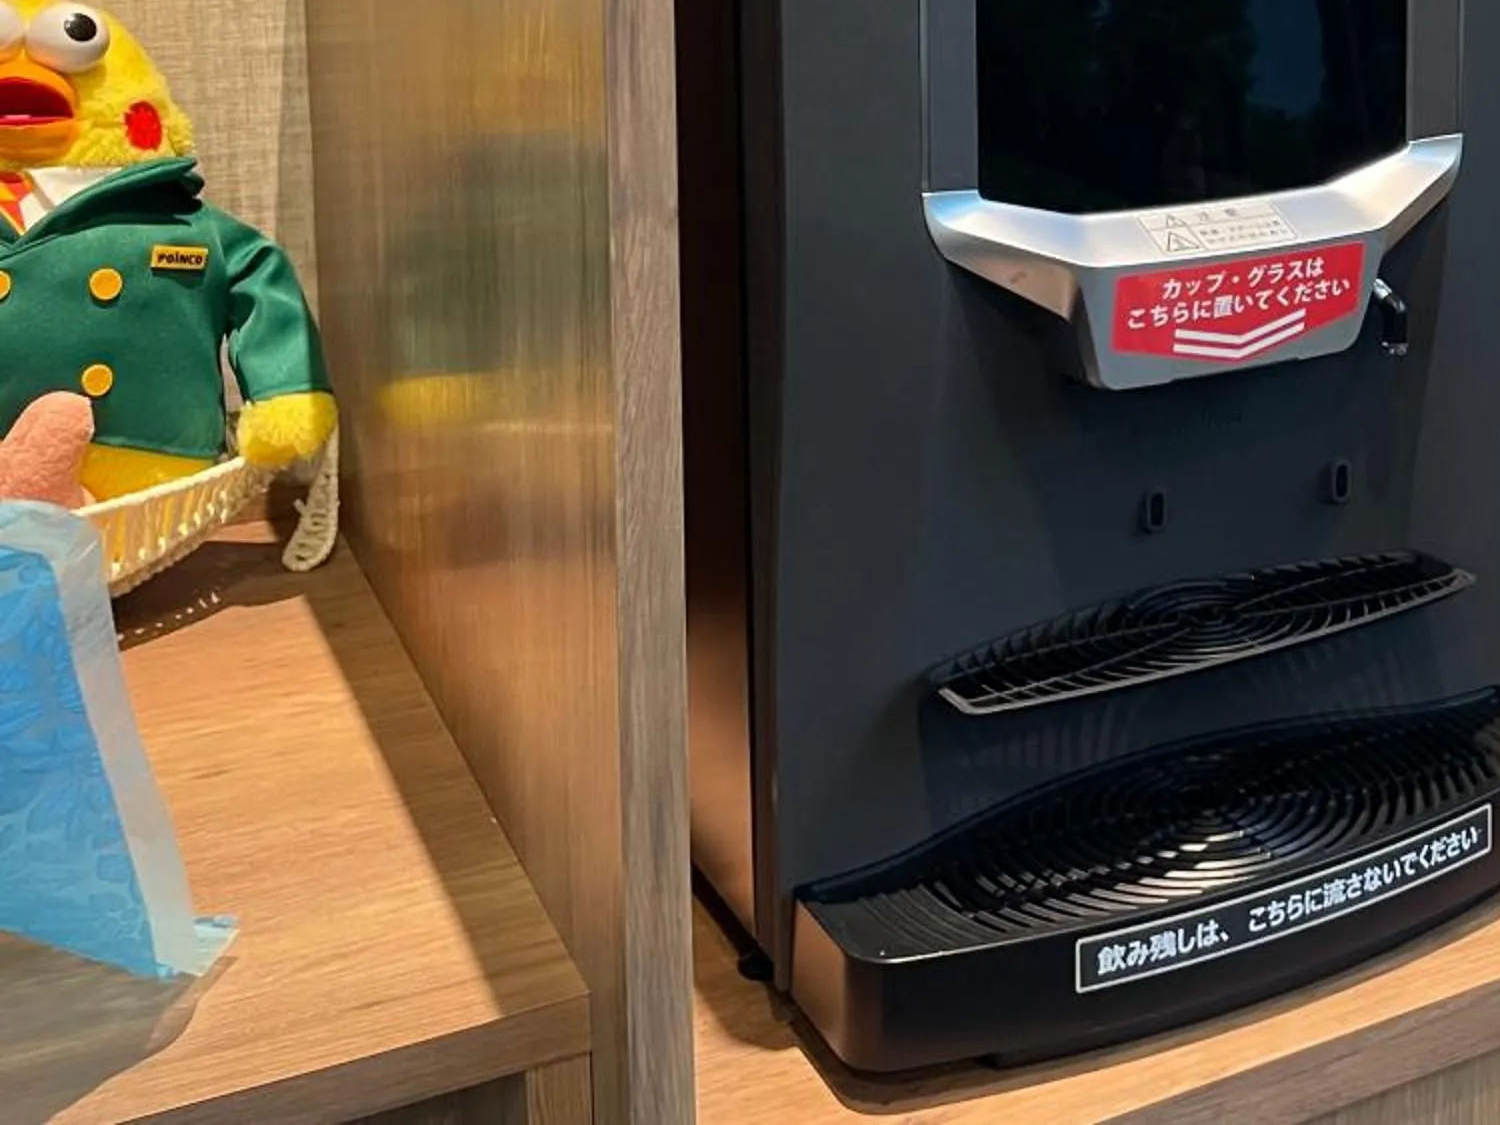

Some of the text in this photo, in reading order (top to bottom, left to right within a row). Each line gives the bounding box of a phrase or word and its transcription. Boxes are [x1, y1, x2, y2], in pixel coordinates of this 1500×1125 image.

[1162, 257, 1325, 300] カップ・グラスは
[1127, 278, 1351, 330] こちらに置いてください
